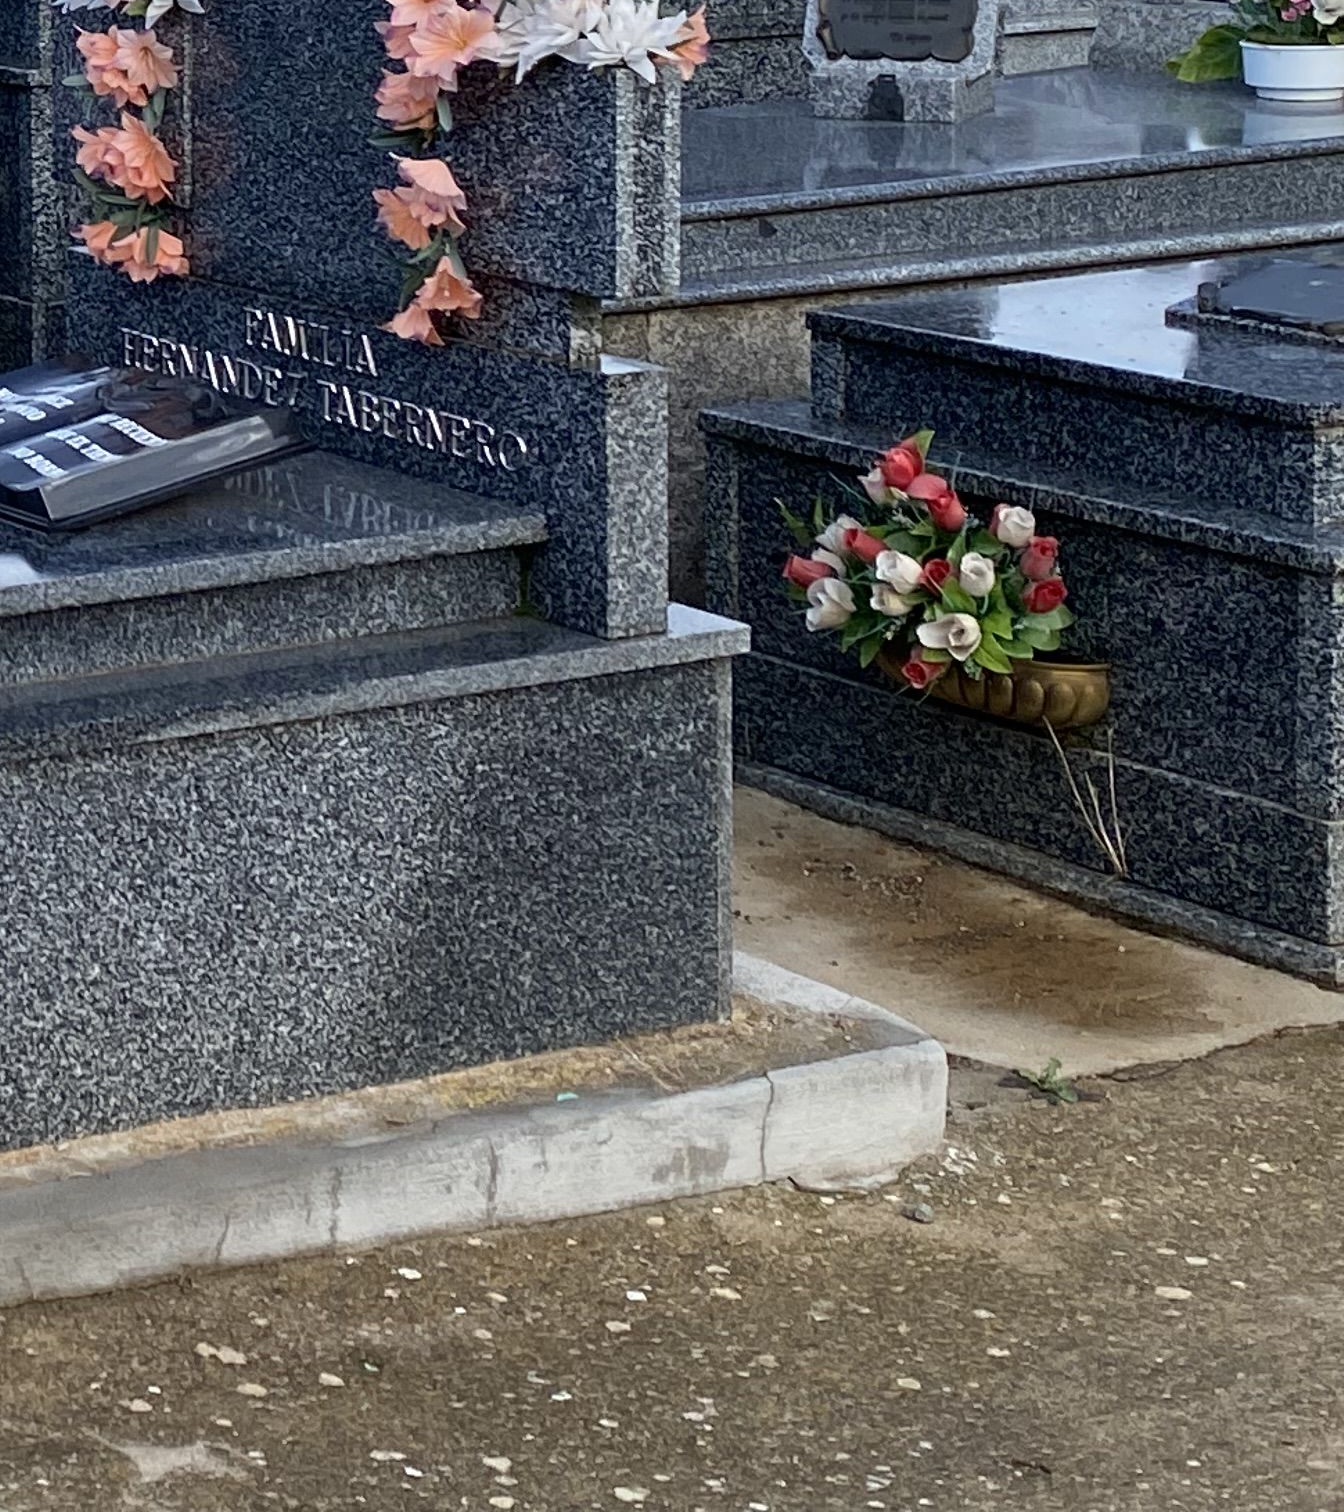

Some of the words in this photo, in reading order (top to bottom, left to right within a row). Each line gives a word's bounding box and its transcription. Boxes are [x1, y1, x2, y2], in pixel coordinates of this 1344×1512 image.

[243, 306, 378, 377] FAMILIA
[120, 327, 308, 406] HERNANDEZ
[316, 378, 527, 472] TABERNERO
